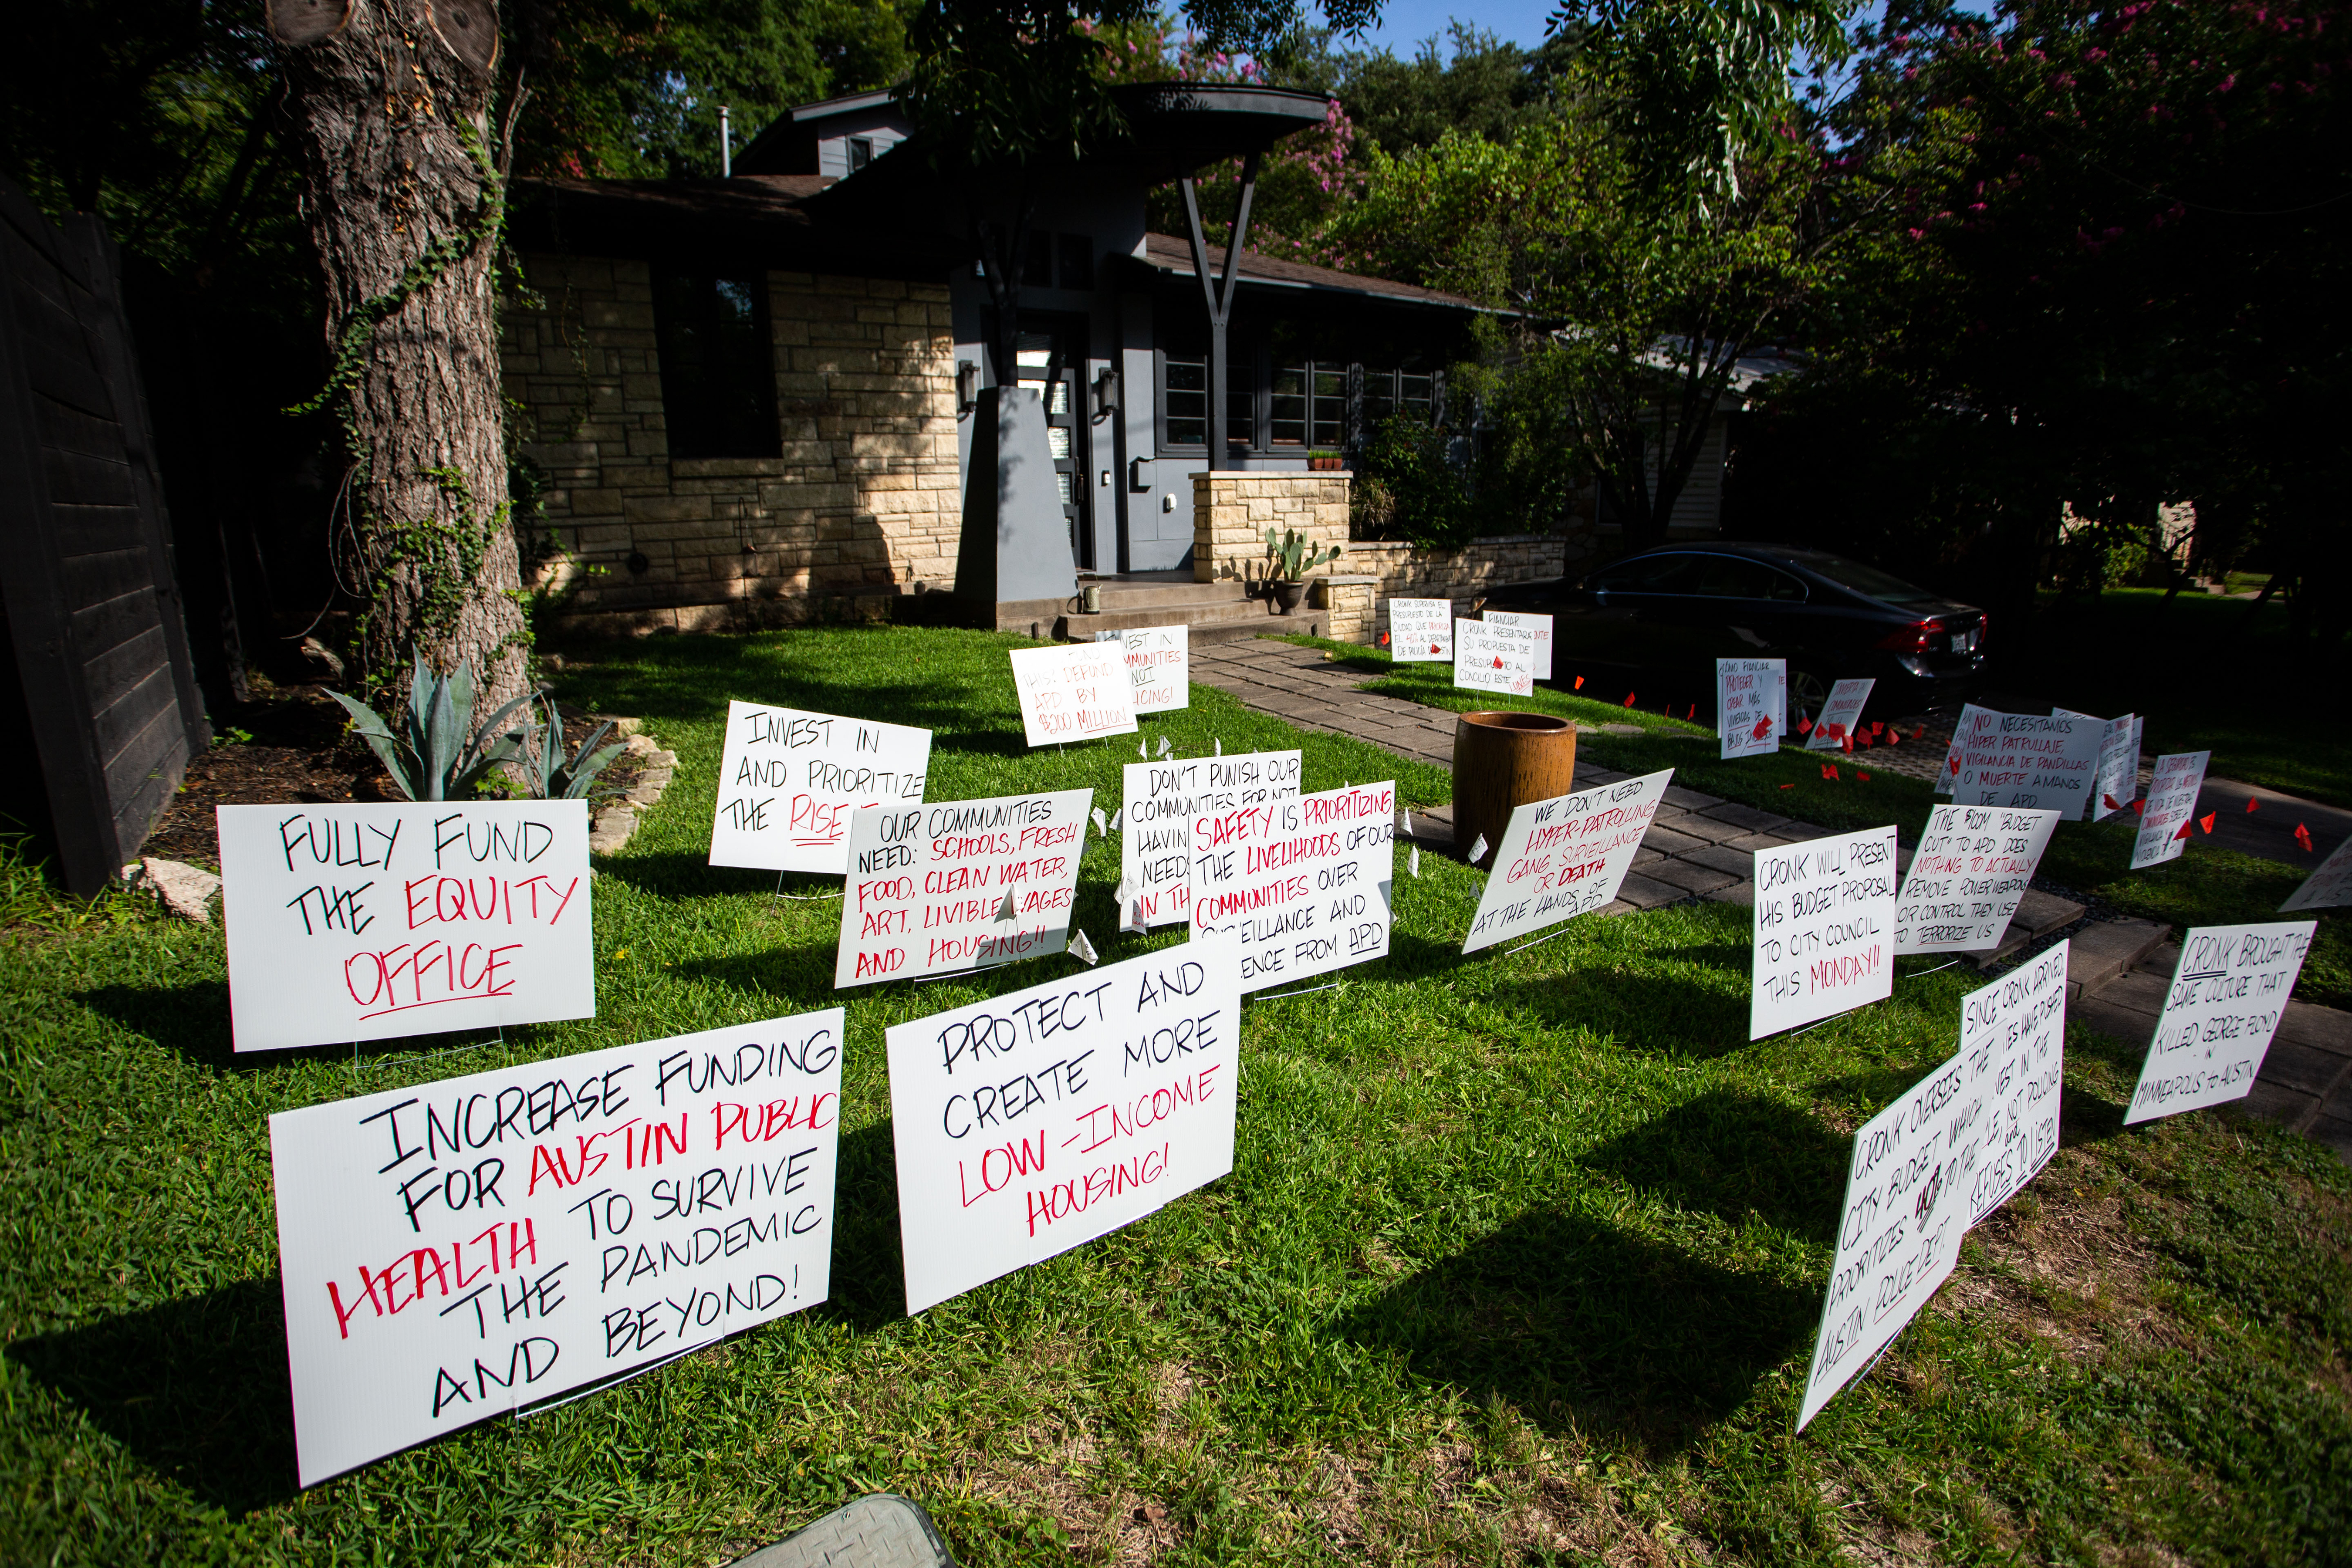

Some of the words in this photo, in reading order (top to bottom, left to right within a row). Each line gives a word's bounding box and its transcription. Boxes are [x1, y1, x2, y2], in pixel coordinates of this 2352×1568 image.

[1392, 610, 1423, 618] PRESUPUESTO
[1393, 622, 1412, 632] CIUDAD
[1416, 622, 1427, 630] QUE
[1429, 622, 1450, 631] PRIORIZA
[1463, 622, 1487, 635] CRONK
[1160, 634, 1172, 646] IN
[1395, 634, 1403, 643] EL
[1406, 632, 1418, 644] 40%
[1398, 646, 1406, 656] DE
[1464, 636, 1474, 650] SU
[1479, 639, 1515, 652] PROPUESTA
[1519, 644, 1530, 654] DE
[1064, 663, 1113, 682] DEFUND
[1132, 666, 1153, 685] NOT
[1460, 669, 1490, 683] CONCILIO
[1495, 674, 1511, 683] ESTE
[1509, 674, 1531, 691] LUNES
[1516, 663, 1526, 672] AL
[1726, 674, 1753, 696] PROTEGER
[1758, 674, 1763, 688] Y
[1035, 693, 1061, 711] APD
[1077, 687, 1095, 703] BY
[1727, 694, 1744, 711] CREAR
[1755, 710, 1762, 721] DE
[744, 713, 834, 748] INVEST
[1039, 713, 1071, 734] $200
[1078, 706, 1126, 729] MILLION
[1973, 714, 1991, 734] NO
[1999, 716, 2072, 733] NECESITAMOS
[1967, 734, 1997, 749] HIPER
[2001, 736, 2064, 754] PATRULLAJE,
[1967, 752, 2014, 767] VIGILANCIA
[2020, 756, 2034, 768] DE
[2037, 757, 2089, 770] PANDILLAS
[809, 760, 925, 798] PRIORITIZE
[1150, 765, 1197, 797] DON'T
[1210, 762, 1259, 787] PUNISH
[1268, 759, 1298, 780] OUR
[1964, 770, 1973, 784] O
[1979, 771, 2028, 786] MUERTE
[790, 794, 849, 838] RISE
[1535, 801, 1560, 824] WE
[1565, 790, 1606, 818] DON'T
[1611, 781, 1642, 803] NEED
[1980, 791, 1998, 806] DE
[2010, 793, 2038, 808] APD
[929, 801, 1051, 839] COMMUNITIES
[1196, 805, 1273, 851] SAFETY
[1303, 790, 1392, 825] PRIORITIZING
[1525, 799, 1656, 855] HYPER-PATROLLING
[1934, 808, 1960, 832] THE
[280, 814, 401, 870] FULLY
[435, 814, 553, 869] FUND
[859, 845, 917, 874] NEED:
[930, 833, 1014, 861] SCHOOLS,
[1019, 822, 1077, 850] FRESH
[1247, 832, 1340, 874] LIVELIHOODS
[1369, 823, 1393, 845] OUR
[1507, 855, 1551, 884] GANG
[1559, 825, 1646, 867] SURVEILLANCE
[1957, 837, 1970, 854] TO
[1973, 837, 1995, 854] APD
[2003, 838, 2028, 854] DOES
[925, 865, 990, 894] CLEAN
[1000, 857, 1068, 885] WATER,
[1534, 872, 1554, 894] OR
[1558, 858, 1605, 886] DEATH
[1760, 854, 1809, 891] CRONK
[1817, 850, 1845, 876] WILL
[1851, 836, 1895, 868] PRESENT
[1914, 856, 1961, 876] NOTHING
[1970, 856, 1984, 873] TO
[1984, 856, 2036, 875] ACTUALLY
[406, 875, 578, 929] EQUITY
[1197, 875, 1308, 928] COMMUNITIES
[1318, 861, 1358, 890] OVER
[1472, 909, 1498, 935] AT
[1500, 899, 1531, 927] THE
[1534, 890, 1579, 917] HANDS
[1589, 878, 1609, 894] OF
[1760, 902, 1782, 930] HIS
[1793, 887, 1837, 919] BUDGET
[1843, 876, 1895, 907] PROPOSAL
[1906, 878, 1952, 899] REMOVE
[924, 897, 1003, 928] LIVIBLE
[1898, 905, 1919, 923] OR
[1920, 903, 1965, 920] CONTROL
[1970, 902, 1995, 918] THEY
[1997, 902, 2017, 916] USE
[928, 925, 1045, 967] HOUSING!!
[1295, 935, 1337, 965] FROM
[1349, 923, 1382, 950] APD
[1791, 929, 1820, 956] CITY
[1826, 918, 1879, 946] COUNCIL
[1894, 928, 1908, 944] TO
[1917, 925, 1973, 943] TERRORIZE
[1977, 924, 1994, 939] US
[345, 940, 523, 1006] OFFICE
[2183, 936, 2238, 972] CRONK
[1764, 972, 1799, 1003] THIS
[1967, 989, 2000, 1035] SINCE
[2003, 974, 2030, 1013] CRONK
[2040, 985, 2062, 1025] PUSHED
[2166, 981, 2202, 1012] SAME
[2205, 976, 2252, 1002] CULTURE
[2257, 971, 2288, 996] THAT
[938, 982, 1112, 1074] PROTECT
[2155, 1022, 2199, 1054] KILLED
[2203, 1015, 2244, 1041] GEORGE
[2247, 1010, 2277, 1035] FLOYD
[944, 1050, 1095, 1138] CREATE
[1125, 1010, 1220, 1077] MORE
[2028, 1061, 2058, 1105] POLICING
[2218, 1059, 2259, 1087] AUSTIN
[360, 1064, 634, 1173] INCREASE
[657, 1030, 836, 1105] FUNDING
[1855, 1111, 1906, 1180] CRONK
[1910, 1064, 1962, 1135] OVERSEES
[528, 1113, 687, 1196] AUSTIN
[711, 1093, 837, 1150] PUBLIC
[1027, 1143, 1169, 1237] HOUSING!
[1842, 1185, 1883, 1251] CITY
[1887, 1132, 1940, 1210] BUDGET
[1971, 1150, 2013, 1213] REFUSES
[327, 1218, 536, 1340] HEALTH
[652, 1147, 818, 1222] SURVIVE
[600, 1205, 821, 1293] PANDEMIC
[1829, 1214, 1907, 1315] PRIORITIZES
[606, 1265, 800, 1358] BEYOND!
